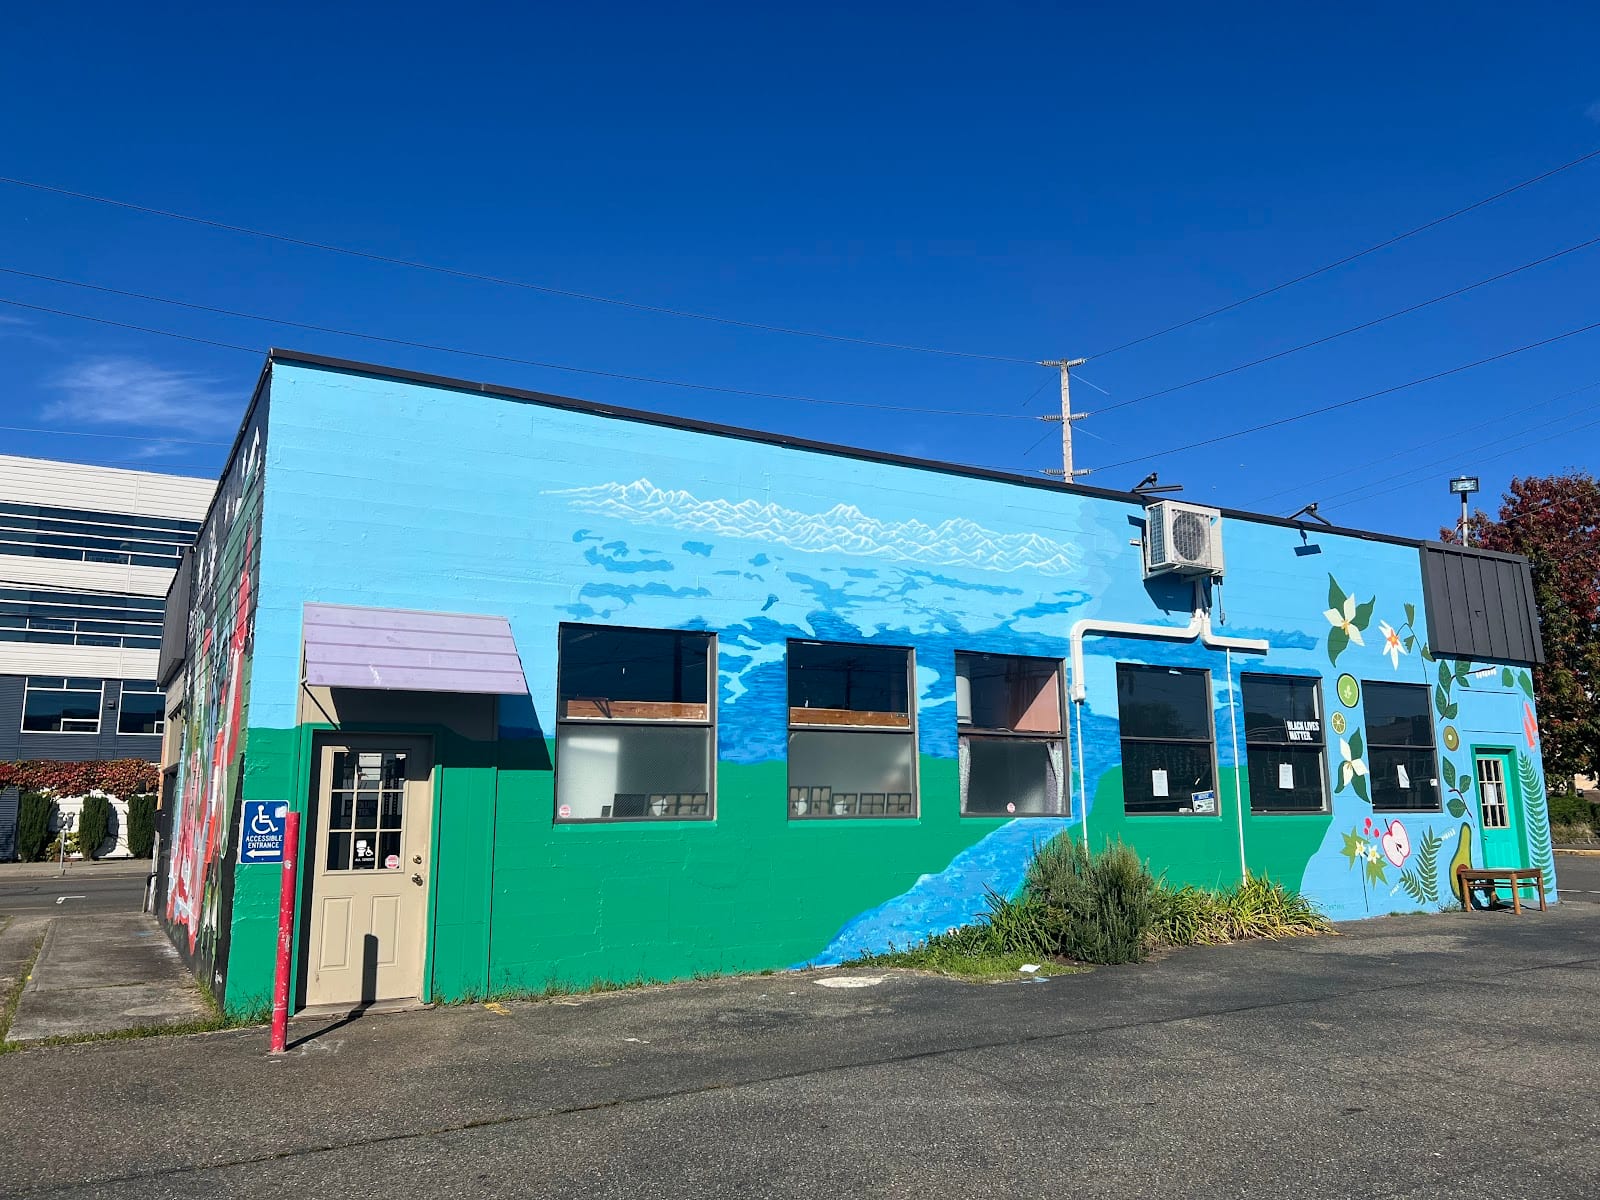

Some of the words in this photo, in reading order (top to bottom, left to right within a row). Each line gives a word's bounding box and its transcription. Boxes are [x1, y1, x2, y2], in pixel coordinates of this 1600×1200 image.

[1286, 720, 1305, 731] BLACK
[1304, 721, 1320, 731] LIVES
[246, 834, 283, 842] ACCESSIBLE
[247, 841, 280, 849] ENTRANCE
